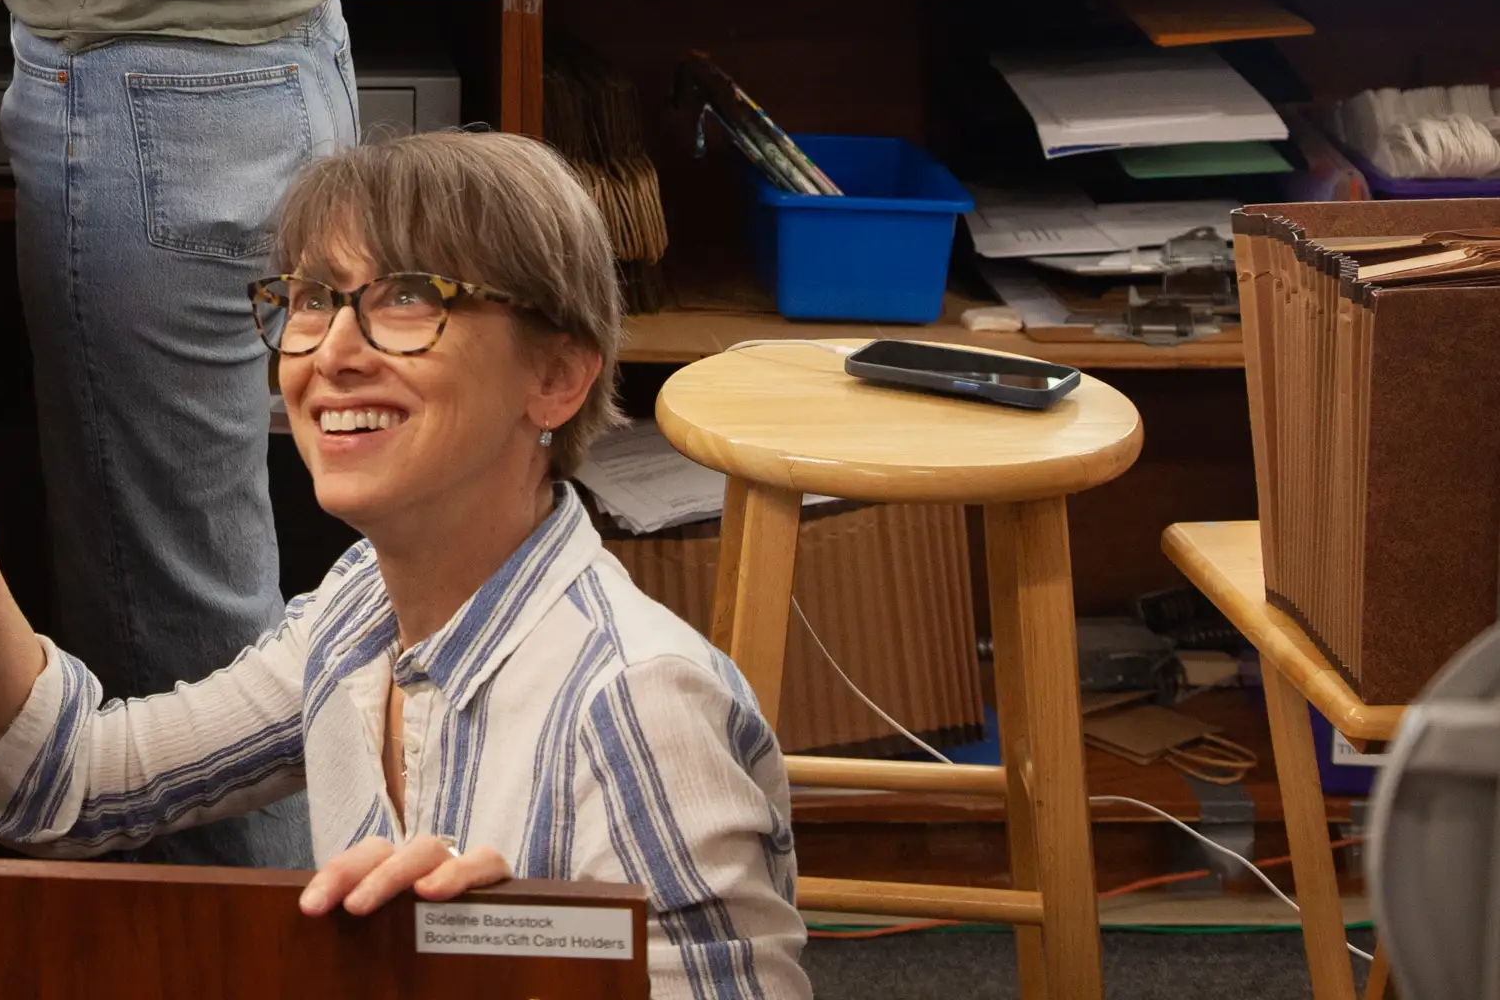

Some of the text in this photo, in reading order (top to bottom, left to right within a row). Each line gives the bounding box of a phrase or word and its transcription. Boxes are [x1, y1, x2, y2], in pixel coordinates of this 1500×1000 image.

[425, 912, 554, 929] Sideline Backstock
[425, 931, 625, 950] Bookmarks/Gift Card Holders
